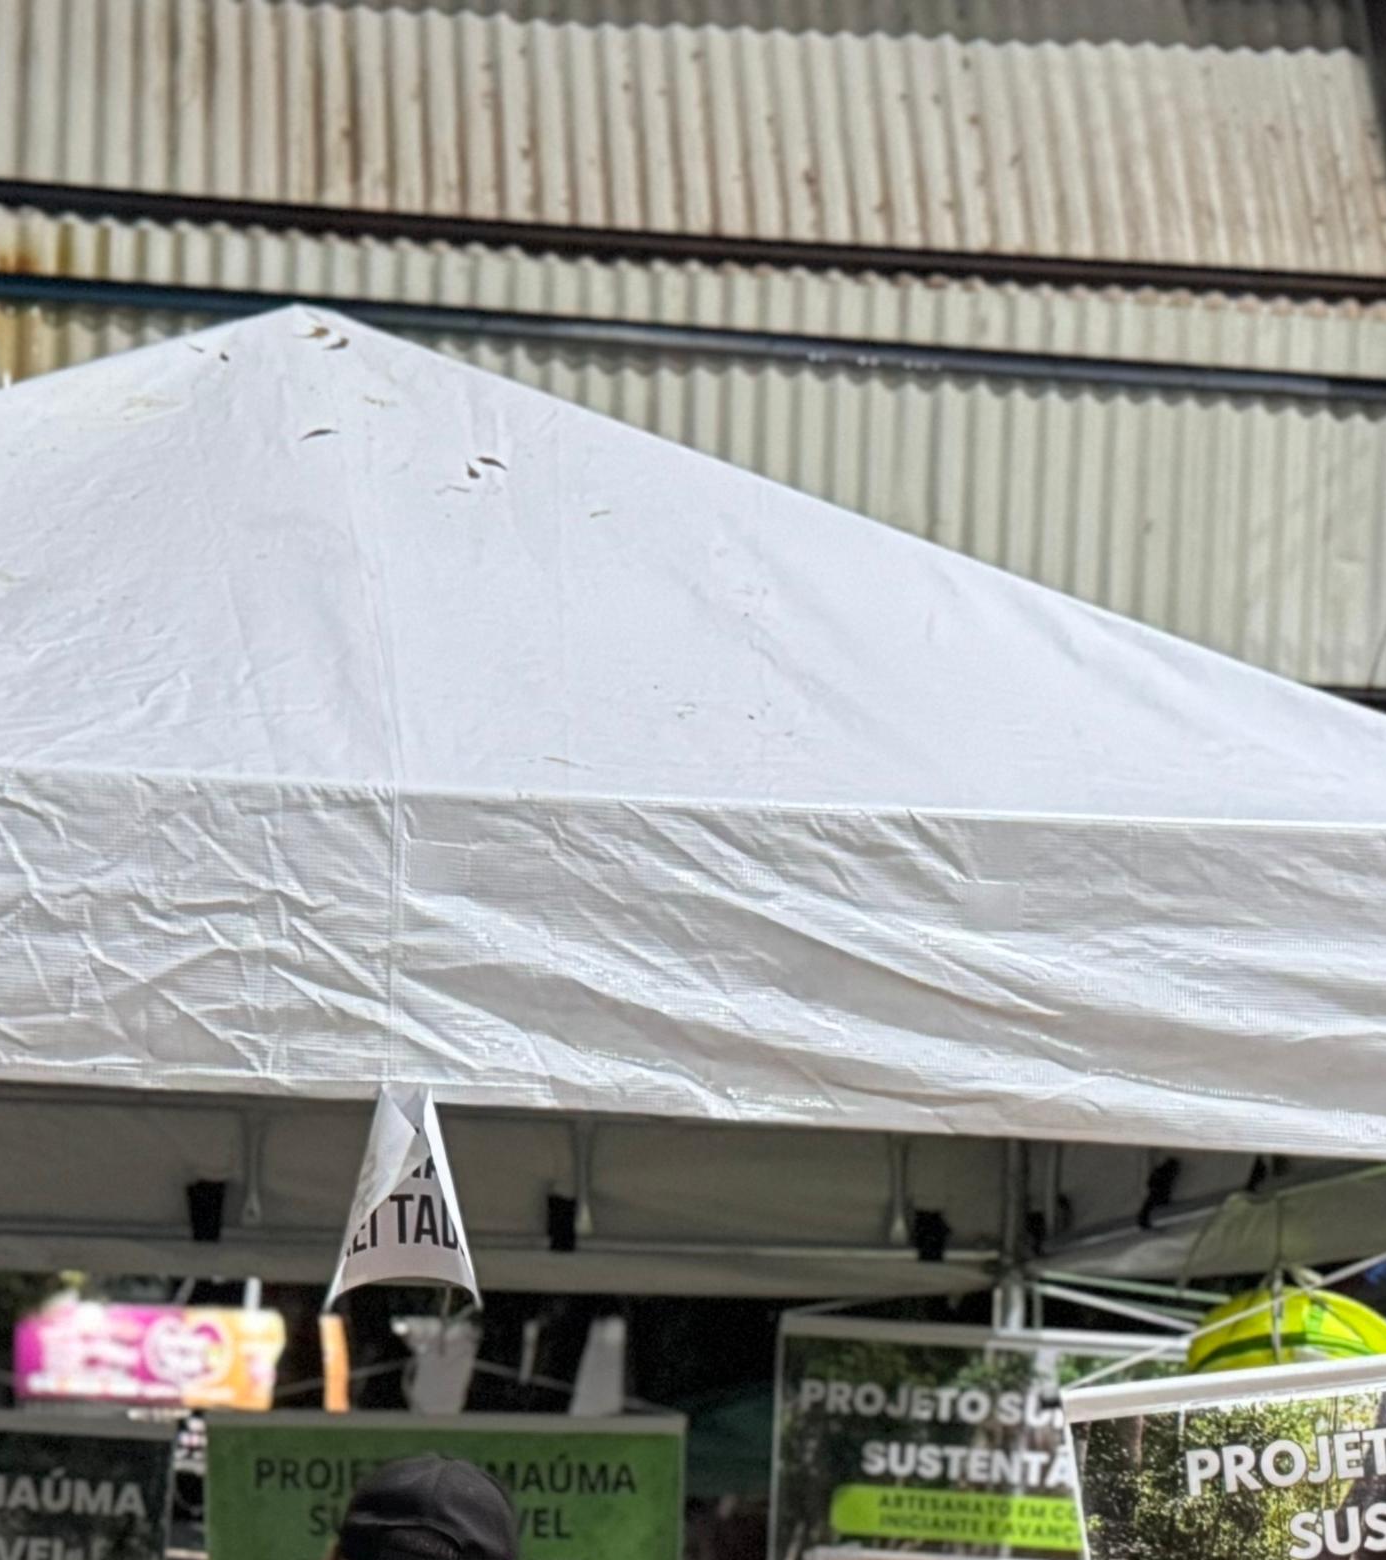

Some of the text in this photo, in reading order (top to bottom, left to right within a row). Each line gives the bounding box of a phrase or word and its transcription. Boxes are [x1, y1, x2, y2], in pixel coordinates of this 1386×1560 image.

[798, 1378, 991, 1426] PROJETO
[861, 1440, 1077, 1488] SUSTENTÁ
[879, 1493, 1012, 1519] ARTESANATO
[1018, 1502, 1047, 1520] EM
